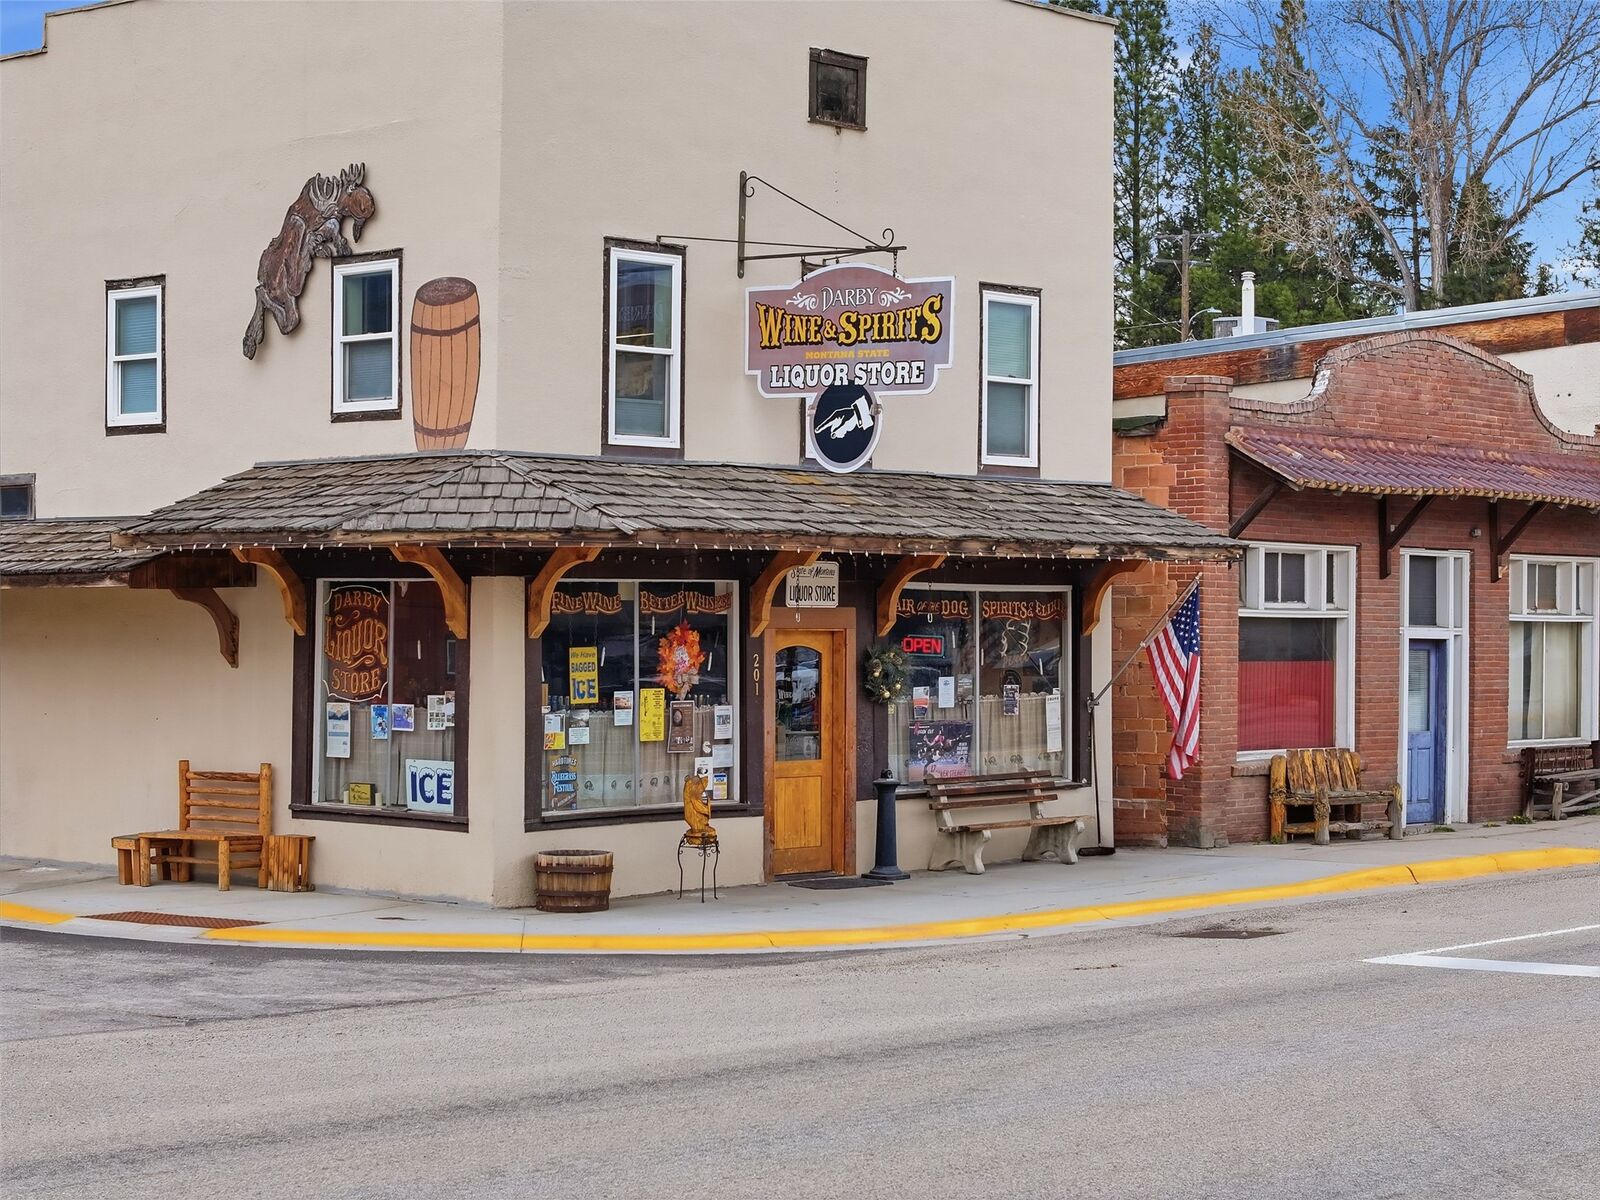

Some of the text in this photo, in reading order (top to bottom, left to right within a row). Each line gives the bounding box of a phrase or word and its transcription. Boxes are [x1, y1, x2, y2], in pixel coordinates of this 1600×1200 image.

[821, 286, 879, 312] DARBY
[756, 293, 945, 350] WINE & SPIRITS
[805, 348, 890, 360] MONTANA STATE
[769, 360, 926, 390] LIQUOR STORE
[333, 590, 382, 613] DARBY
[551, 591, 623, 610] FINE WINE
[639, 590, 685, 610] BETTER
[789, 585, 836, 602] LIQUOR STORE
[896, 598, 916, 614] AIR
[941, 599, 969, 616] DOG
[982, 600, 1027, 618] SPIRITS
[1027, 601, 1034, 617] &
[325, 615, 388, 668] LIQUOR
[902, 637, 942, 654] OPEN
[571, 661, 596, 672] BAGGED
[331, 668, 381, 694] STORE
[571, 677, 597, 700] ICE
[408, 764, 454, 805] ICE
